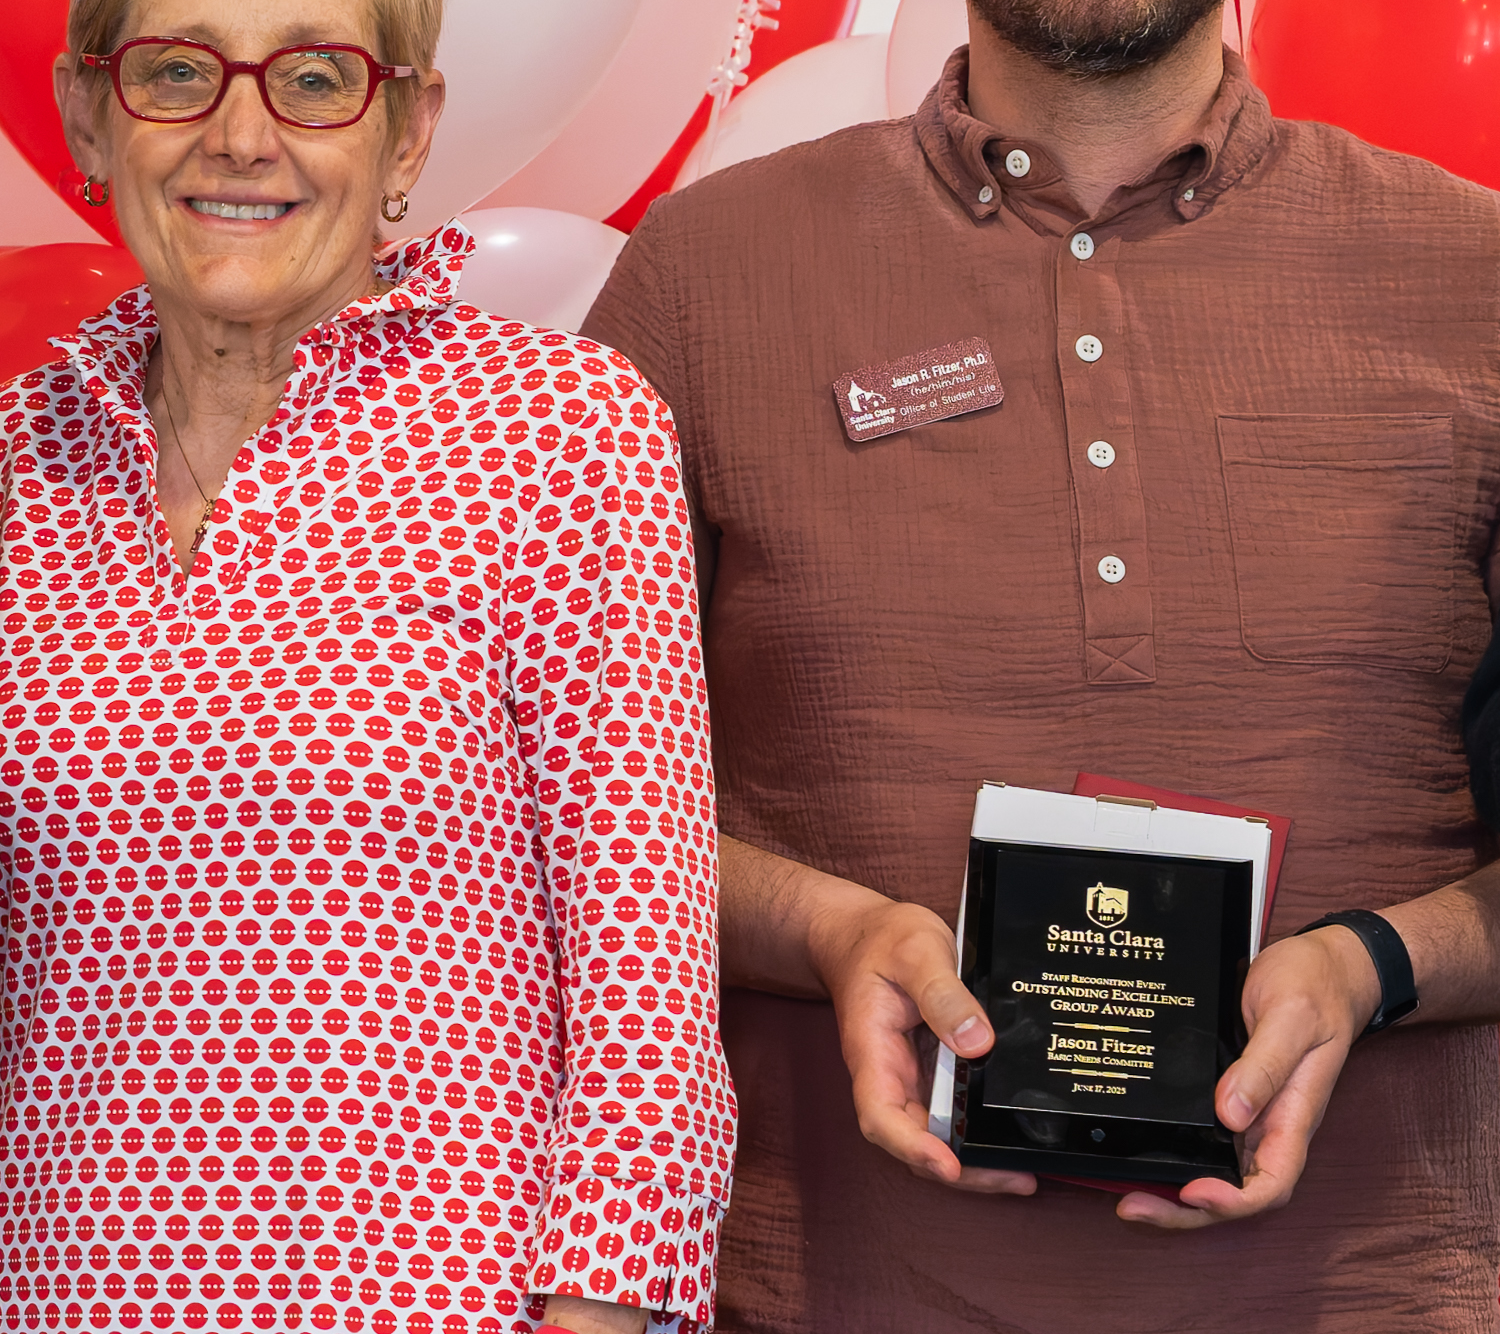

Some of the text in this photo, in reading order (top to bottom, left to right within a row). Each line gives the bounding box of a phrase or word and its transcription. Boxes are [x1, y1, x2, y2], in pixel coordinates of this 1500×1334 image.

[891, 353, 988, 388] Jason R. Fitzer, Ph.D.
[900, 383, 996, 416] Office of Student Life
[850, 407, 896, 425] Santa Clara
[854, 416, 895, 432] University
[1047, 924, 1165, 949] Santa Clara
[1047, 942, 1165, 960] UNIVERSITY
[1042, 972, 1166, 990] STAFF RECOGNITION EVENT
[1012, 981, 1195, 1007] OUTSTANDING EXCELLENCE
[1050, 999, 1155, 1018] GROUP AWARD
[1047, 1034, 1155, 1056] Jason Fitzer
